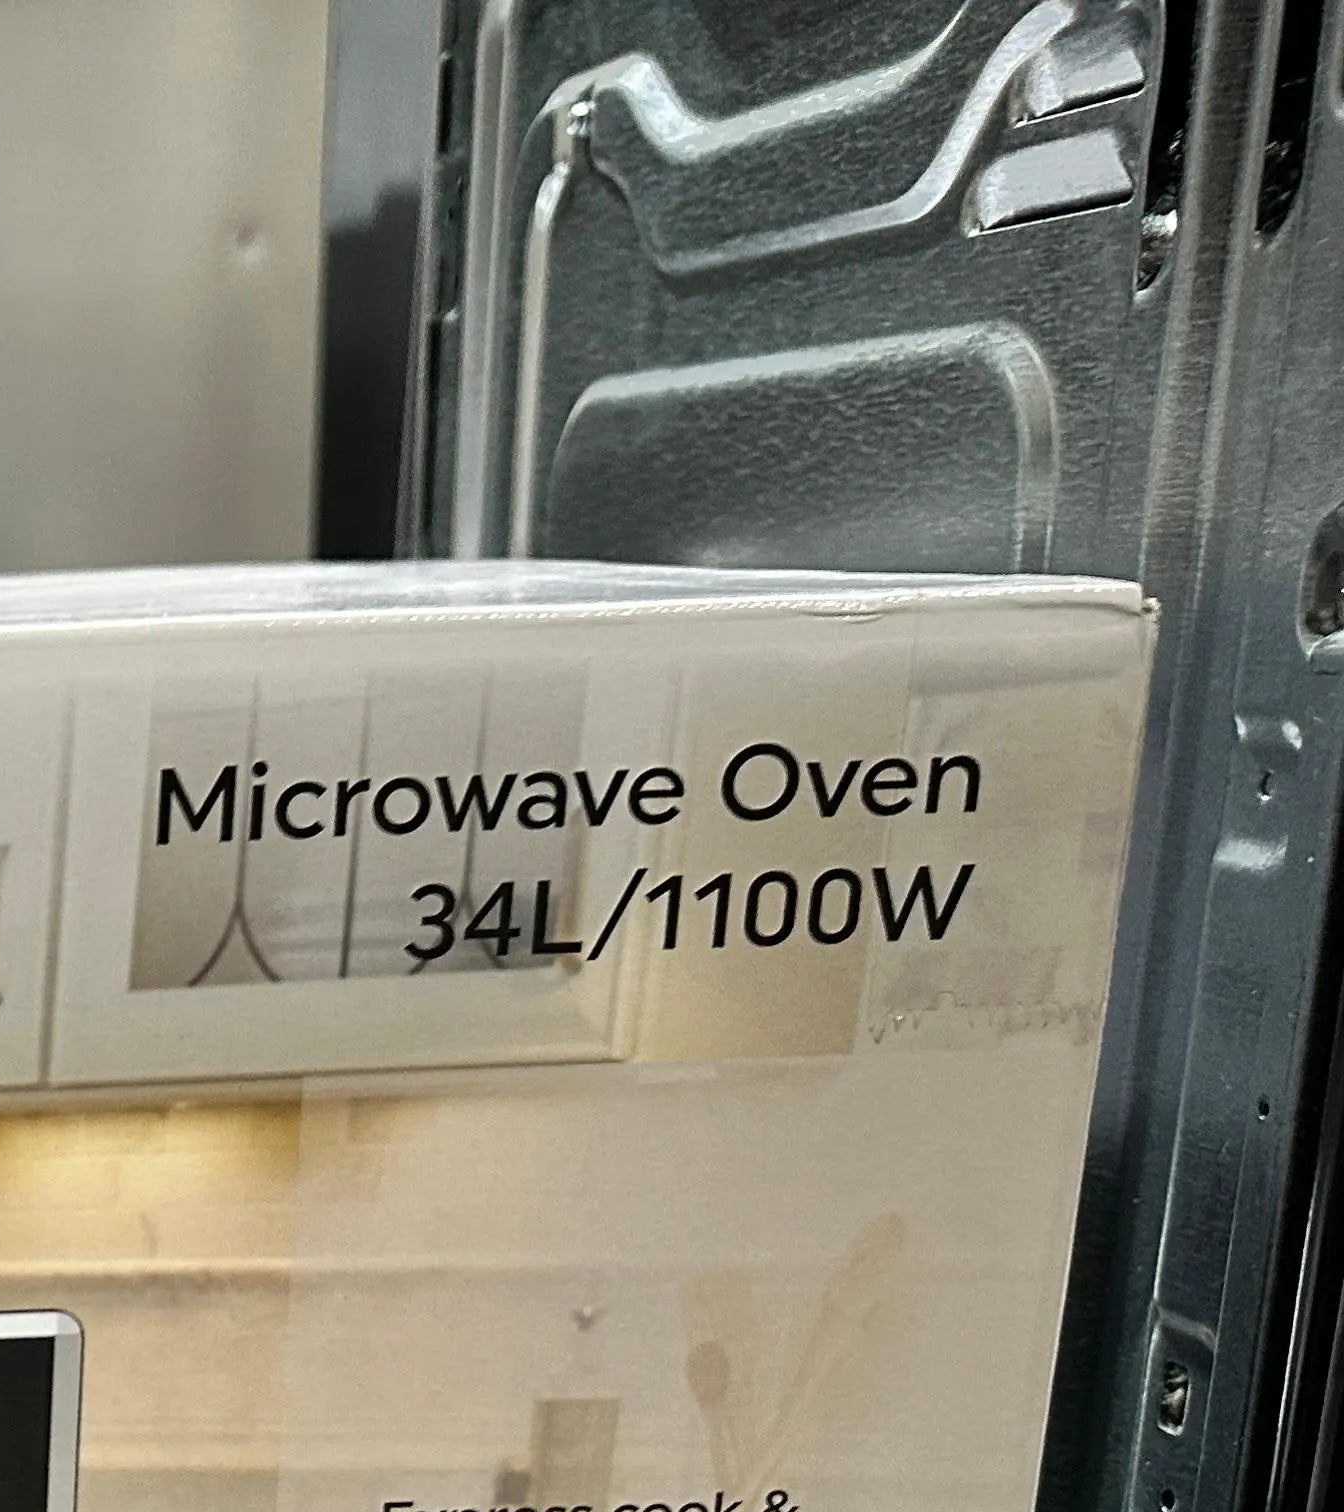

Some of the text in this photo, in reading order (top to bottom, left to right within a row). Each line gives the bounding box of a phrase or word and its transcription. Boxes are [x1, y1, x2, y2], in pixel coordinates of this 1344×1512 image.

[155, 741, 982, 846] Microwave Oven
[403, 862, 976, 962] 34L/1100W
